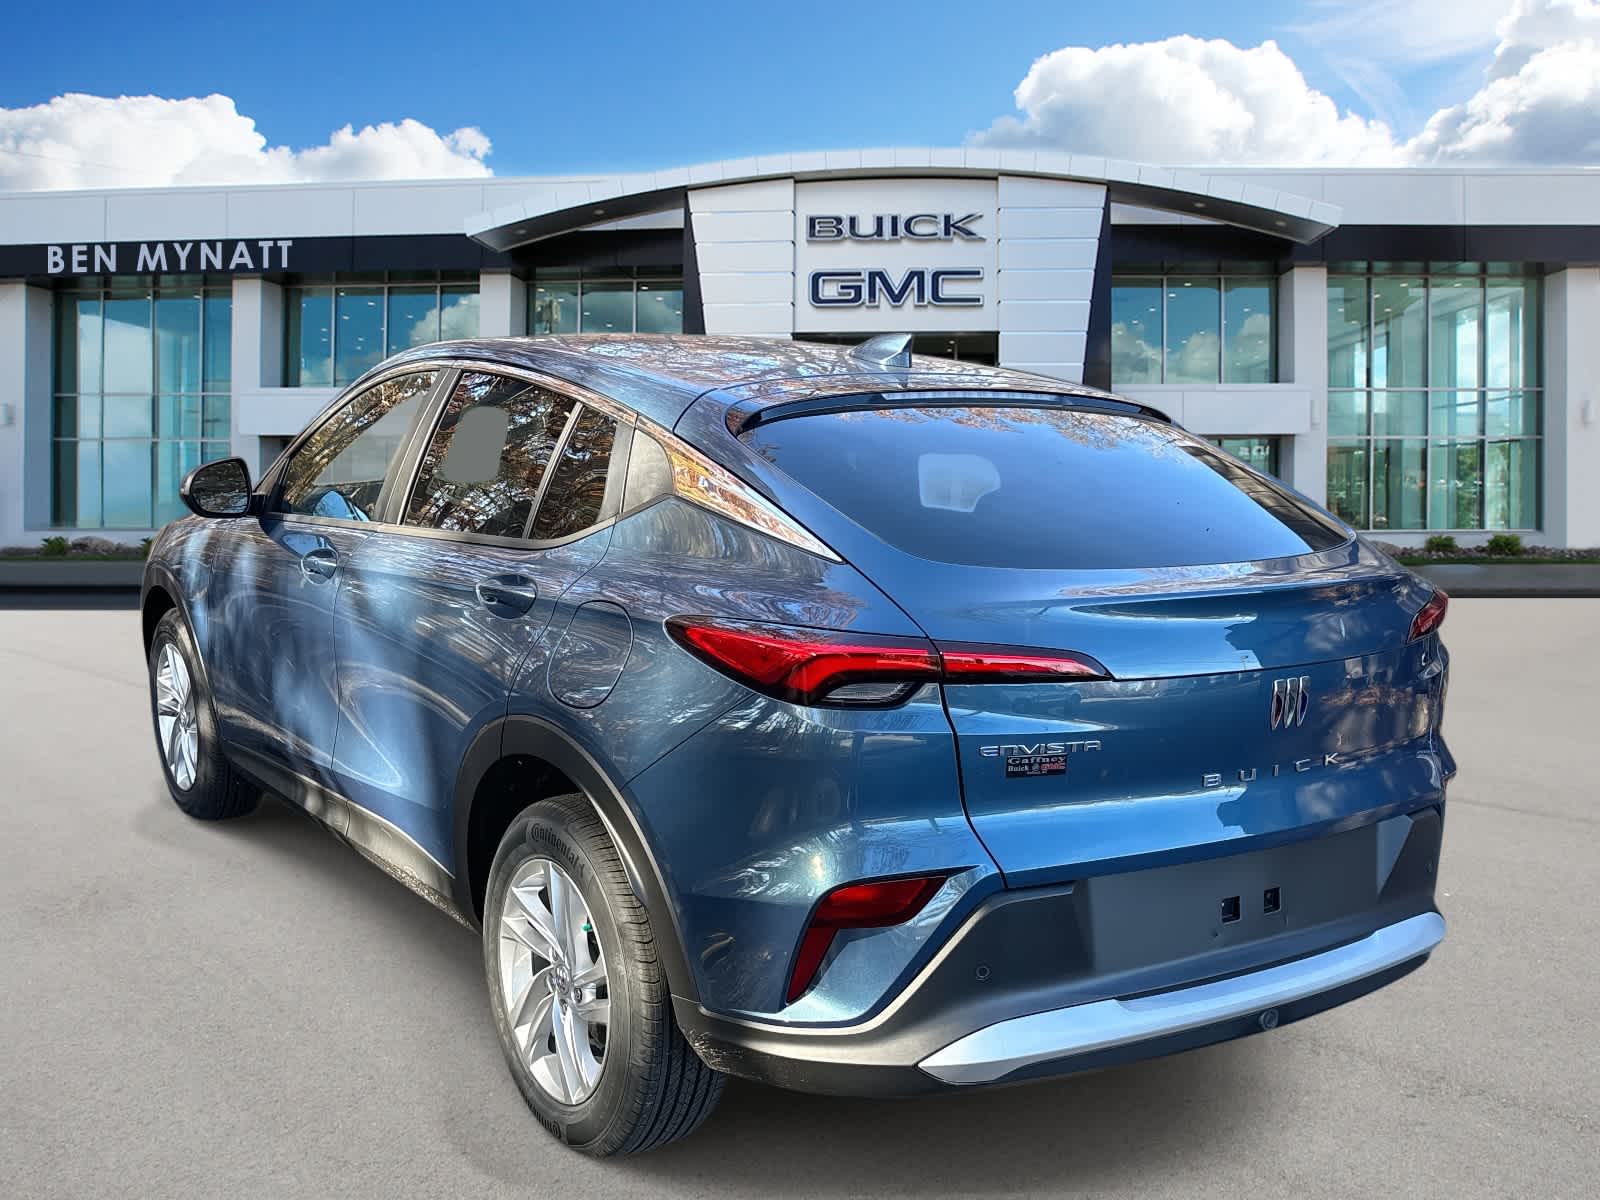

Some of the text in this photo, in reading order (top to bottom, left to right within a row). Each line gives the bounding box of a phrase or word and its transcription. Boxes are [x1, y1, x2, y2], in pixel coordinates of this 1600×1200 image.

[806, 213, 986, 242] BUICK
[47, 240, 293, 274] BEN MYNATT
[808, 267, 984, 308] GMC
[979, 740, 1101, 757] ENVISTA
[1202, 752, 1340, 787] BUICK
